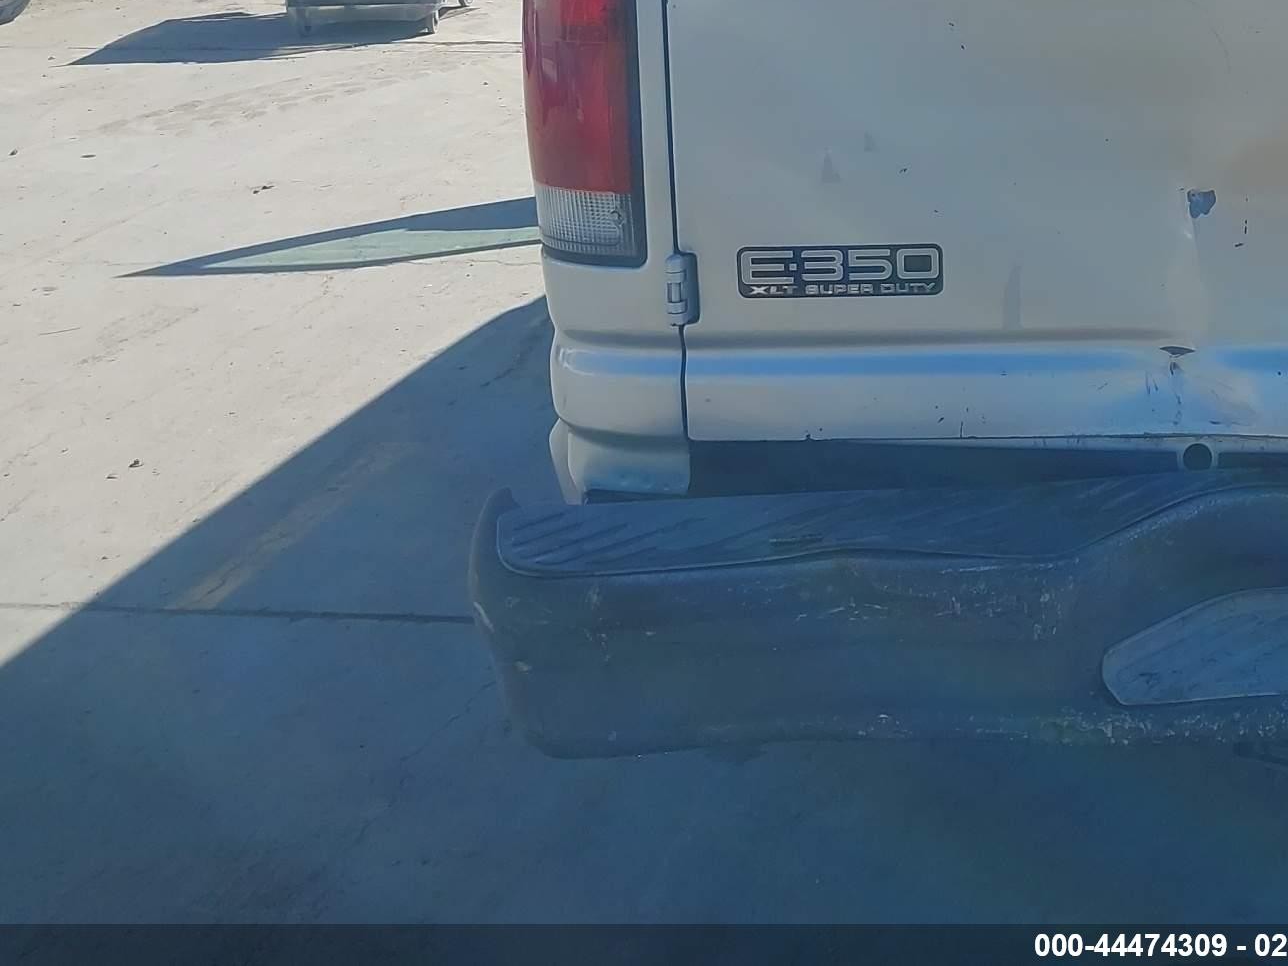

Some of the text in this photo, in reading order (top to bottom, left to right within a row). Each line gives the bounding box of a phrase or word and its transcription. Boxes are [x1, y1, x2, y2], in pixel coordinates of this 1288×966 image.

[749, 282, 936, 295] XLT SUPER DUTY
